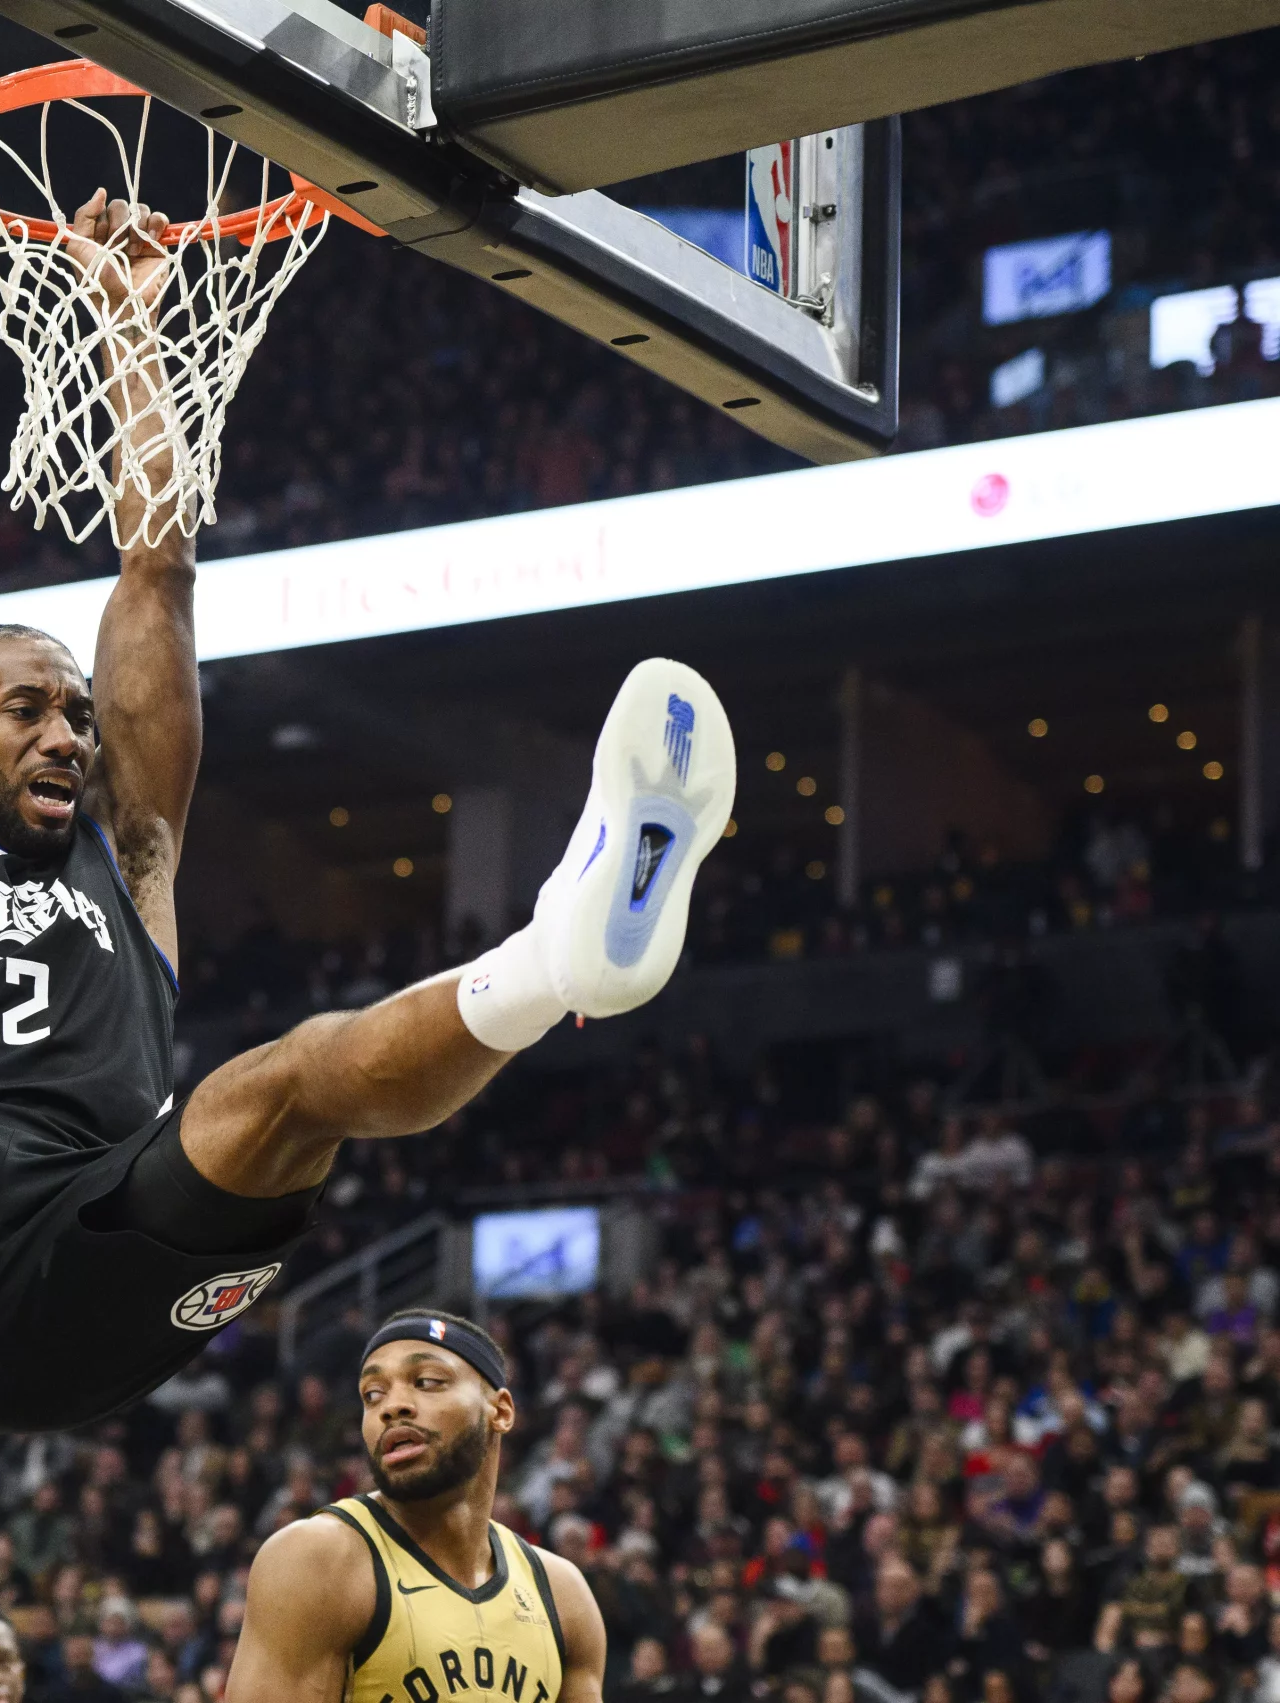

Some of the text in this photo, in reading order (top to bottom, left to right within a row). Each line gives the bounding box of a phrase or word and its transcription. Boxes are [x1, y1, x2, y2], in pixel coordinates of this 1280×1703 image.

[752, 243, 774, 284] NBA
[2, 956, 51, 1046] 2
[379, 1647, 550, 1703] ORONT
